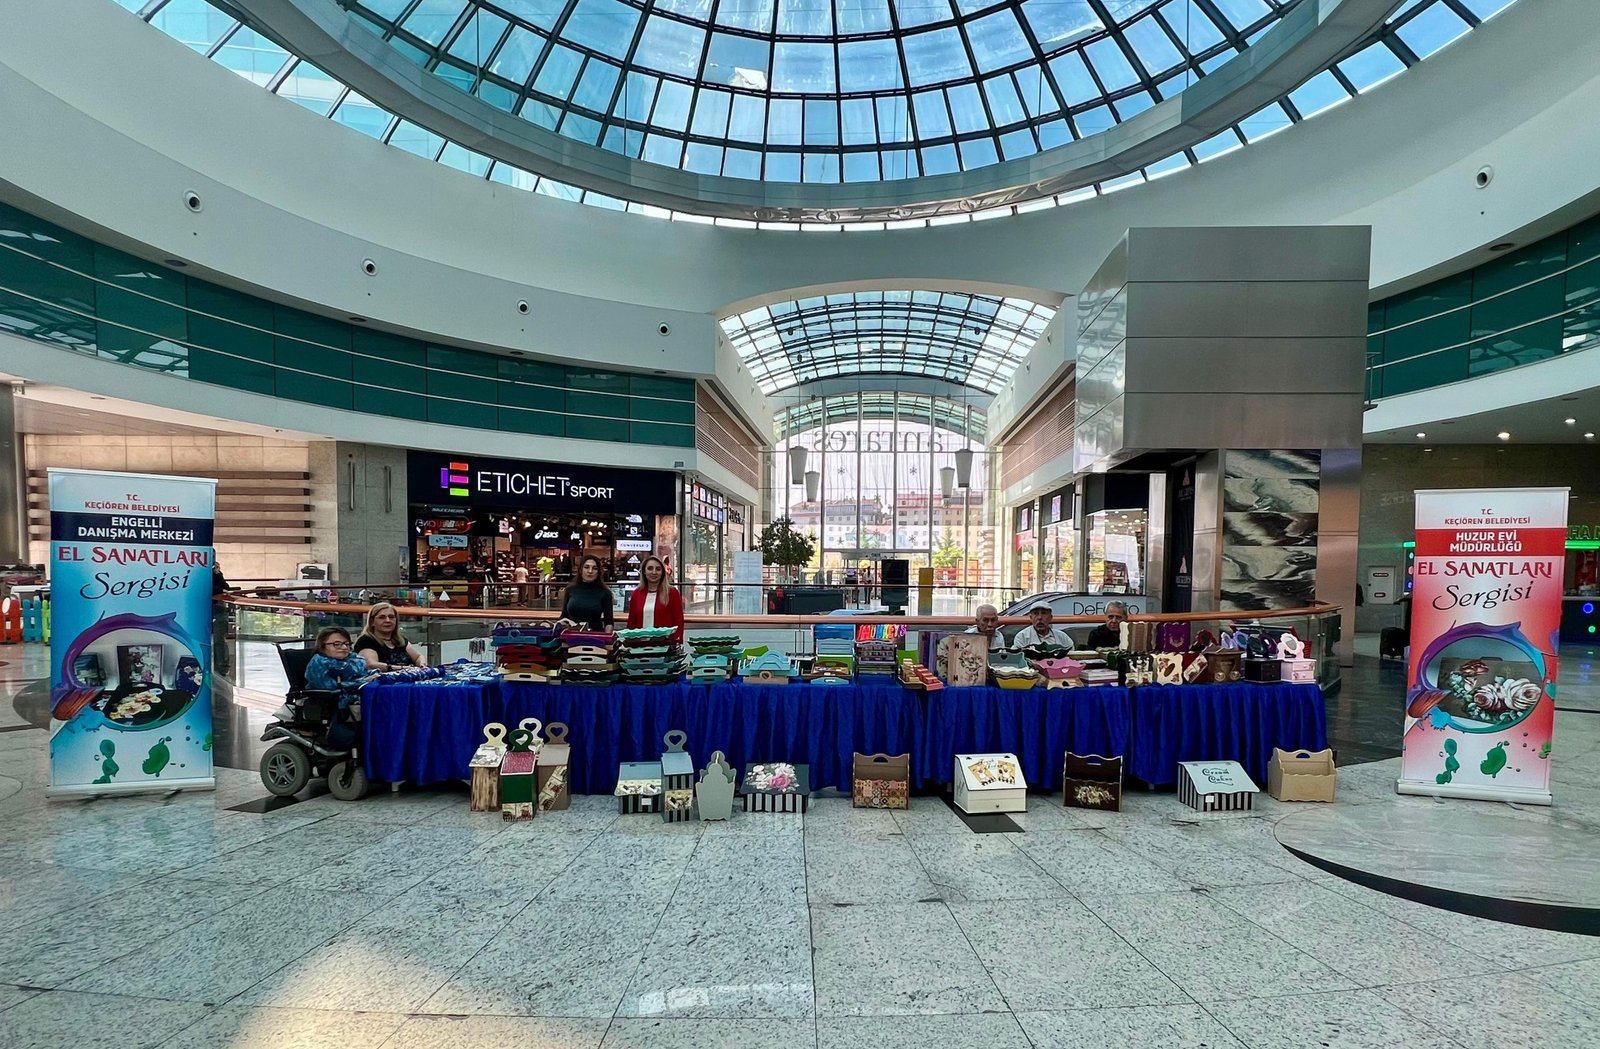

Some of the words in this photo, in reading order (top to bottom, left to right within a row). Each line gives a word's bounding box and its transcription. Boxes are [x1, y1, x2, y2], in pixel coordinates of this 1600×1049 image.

[477, 471, 570, 497] ETICHET
[570, 485, 614, 499] SPORT
[126, 493, 141, 502] T.C.
[84, 501, 129, 511] KEÇİÖREN
[131, 503, 180, 513] BELEDİYESİ
[111, 516, 163, 529] ENGELLİ
[1444, 517, 1483, 526] KEÇİÖREN
[1485, 516, 1531, 525] BELEDİYESİ
[78, 526, 138, 540] DANIŞMA
[141, 528, 194, 541] MERKEZİ
[1456, 531, 1495, 541] HUZUR
[1498, 530, 1517, 541] EVİ
[1449, 540, 1522, 553] MÜDÜRLÜĞÜ
[58, 546, 85, 561] EL
[91, 546, 209, 568] SANATLARI
[1418, 561, 1438, 576] EL
[1444, 560, 1553, 579] SANATLARI
[79, 569, 191, 600] Sergisi
[1432, 580, 1535, 611] Sergisi
